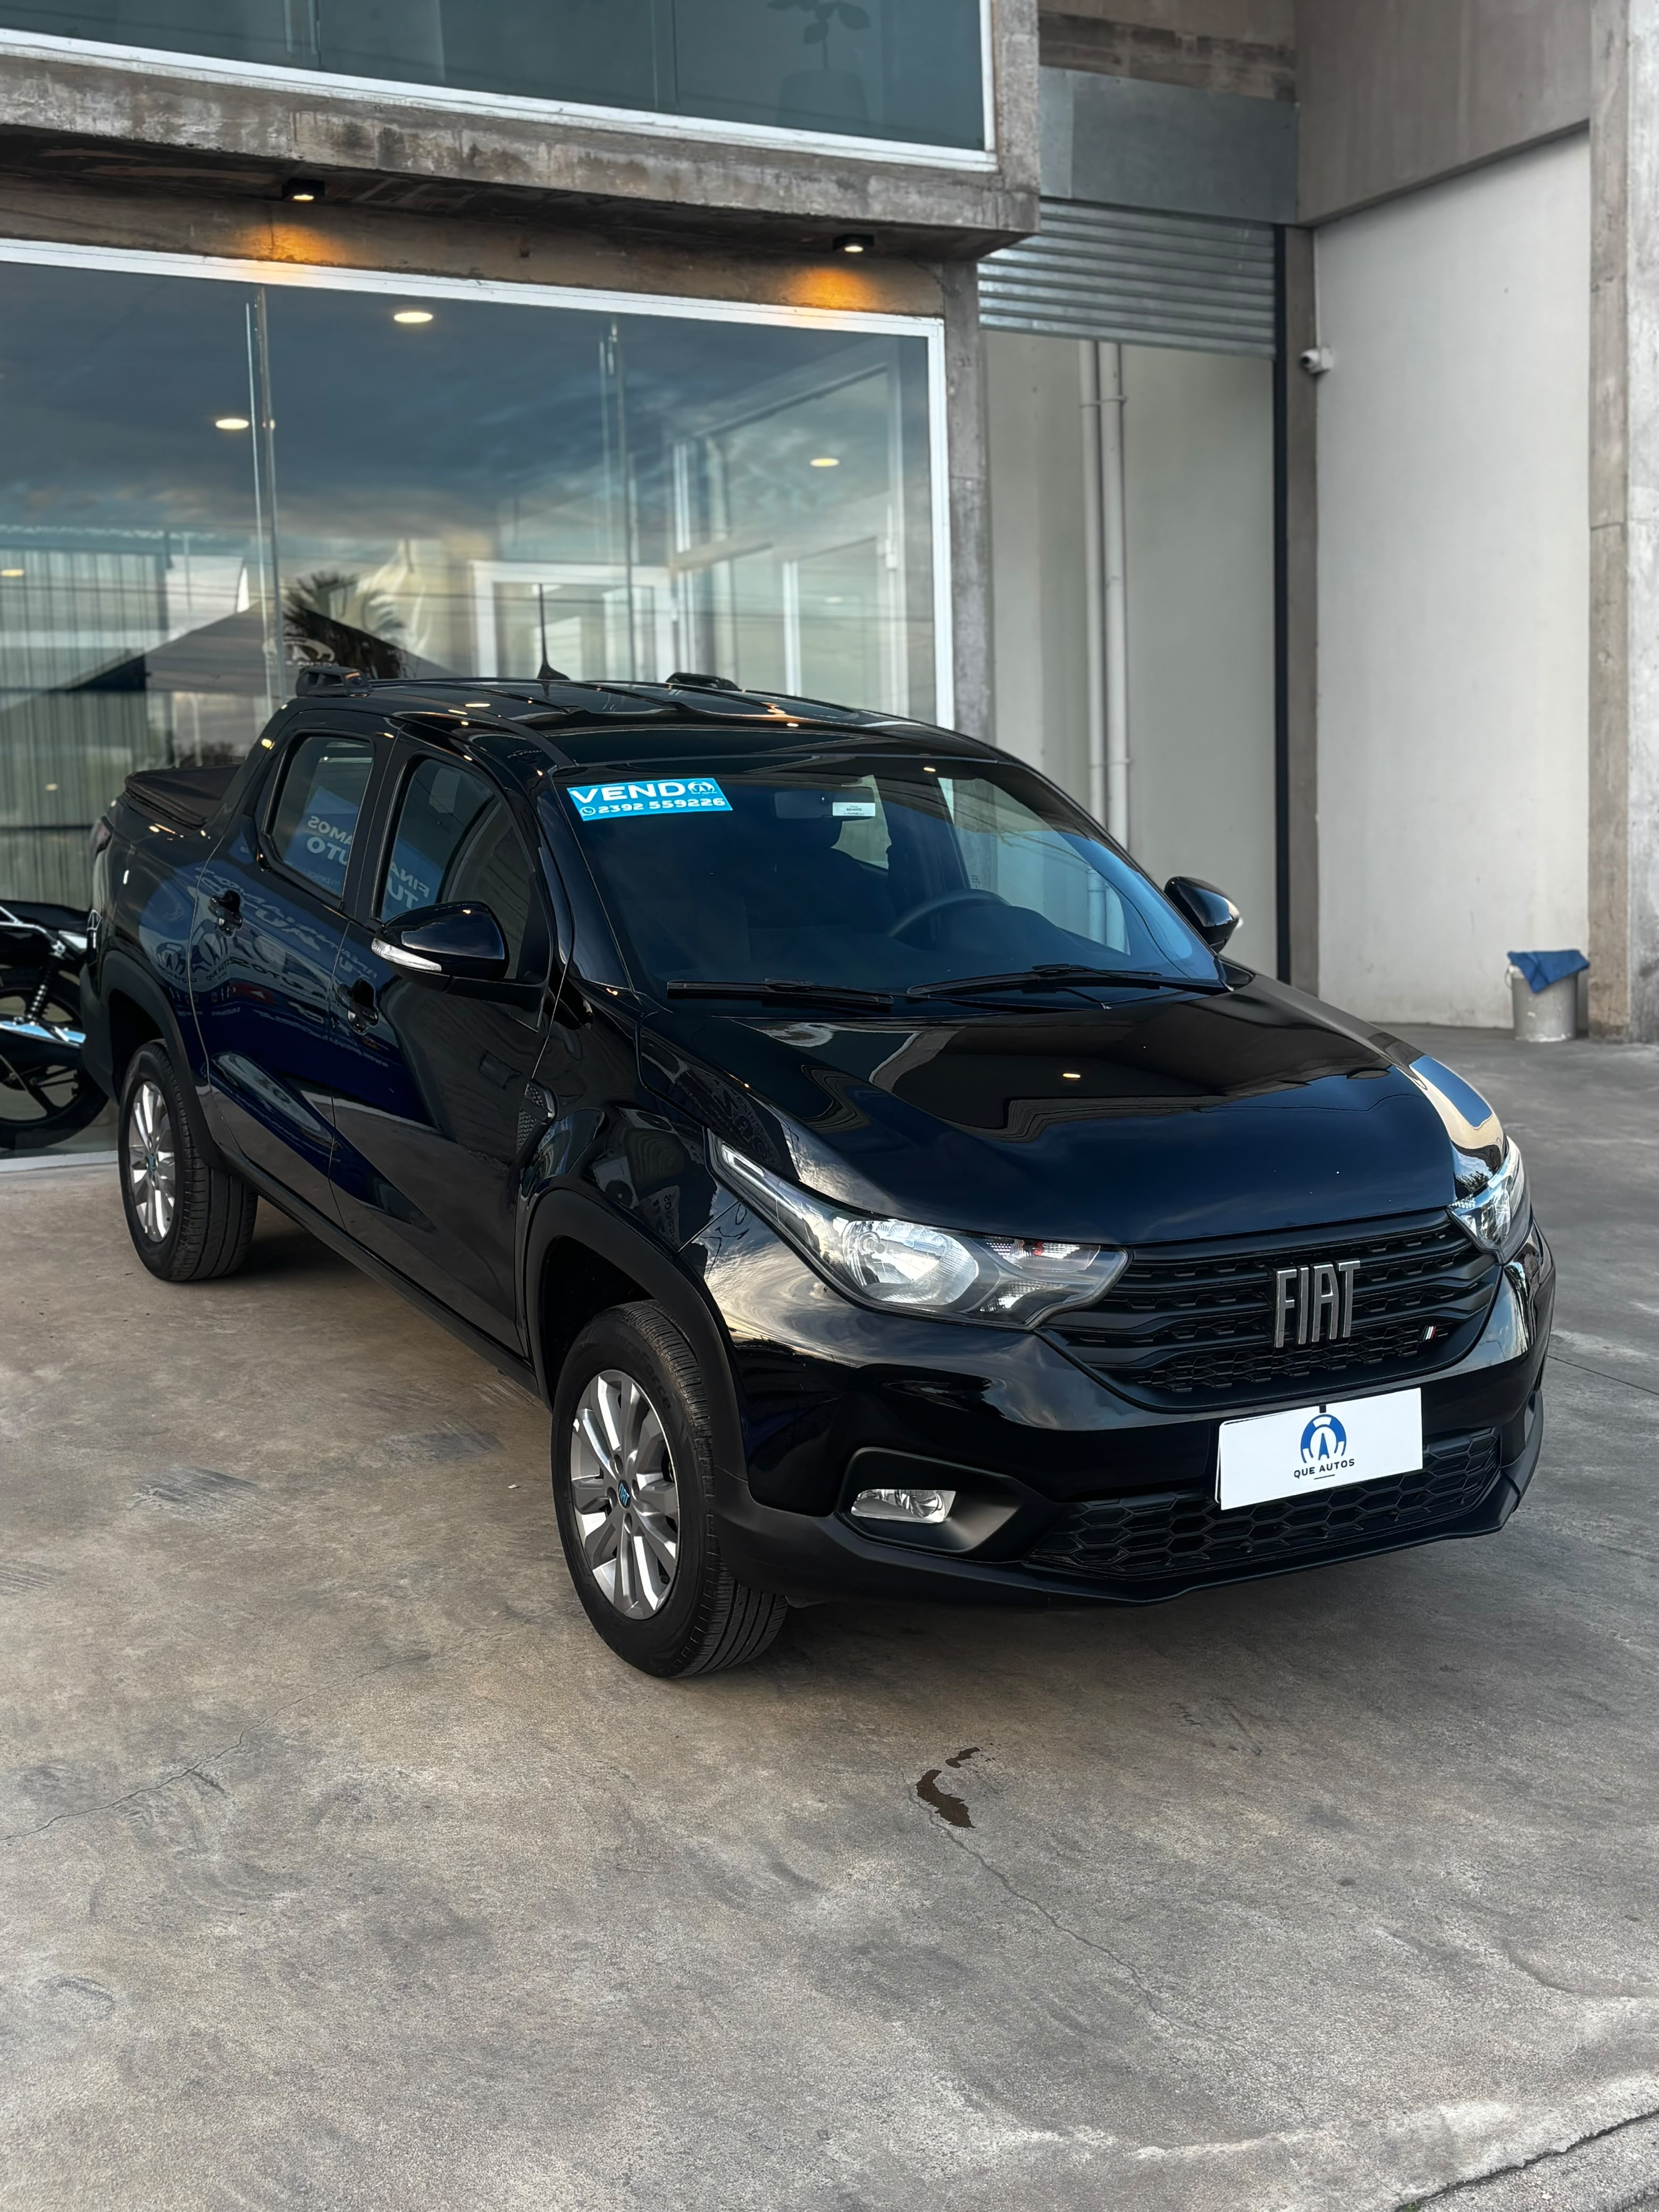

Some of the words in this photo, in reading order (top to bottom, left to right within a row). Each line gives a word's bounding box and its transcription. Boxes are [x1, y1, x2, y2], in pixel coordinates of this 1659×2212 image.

[598, 803, 644, 814] 2392
[649, 798, 725, 809] 559226
[1276, 1259, 1361, 1347] FIAT
[1294, 1467, 1315, 1479] QUE
[1319, 1459, 1355, 1472] AUTOS
